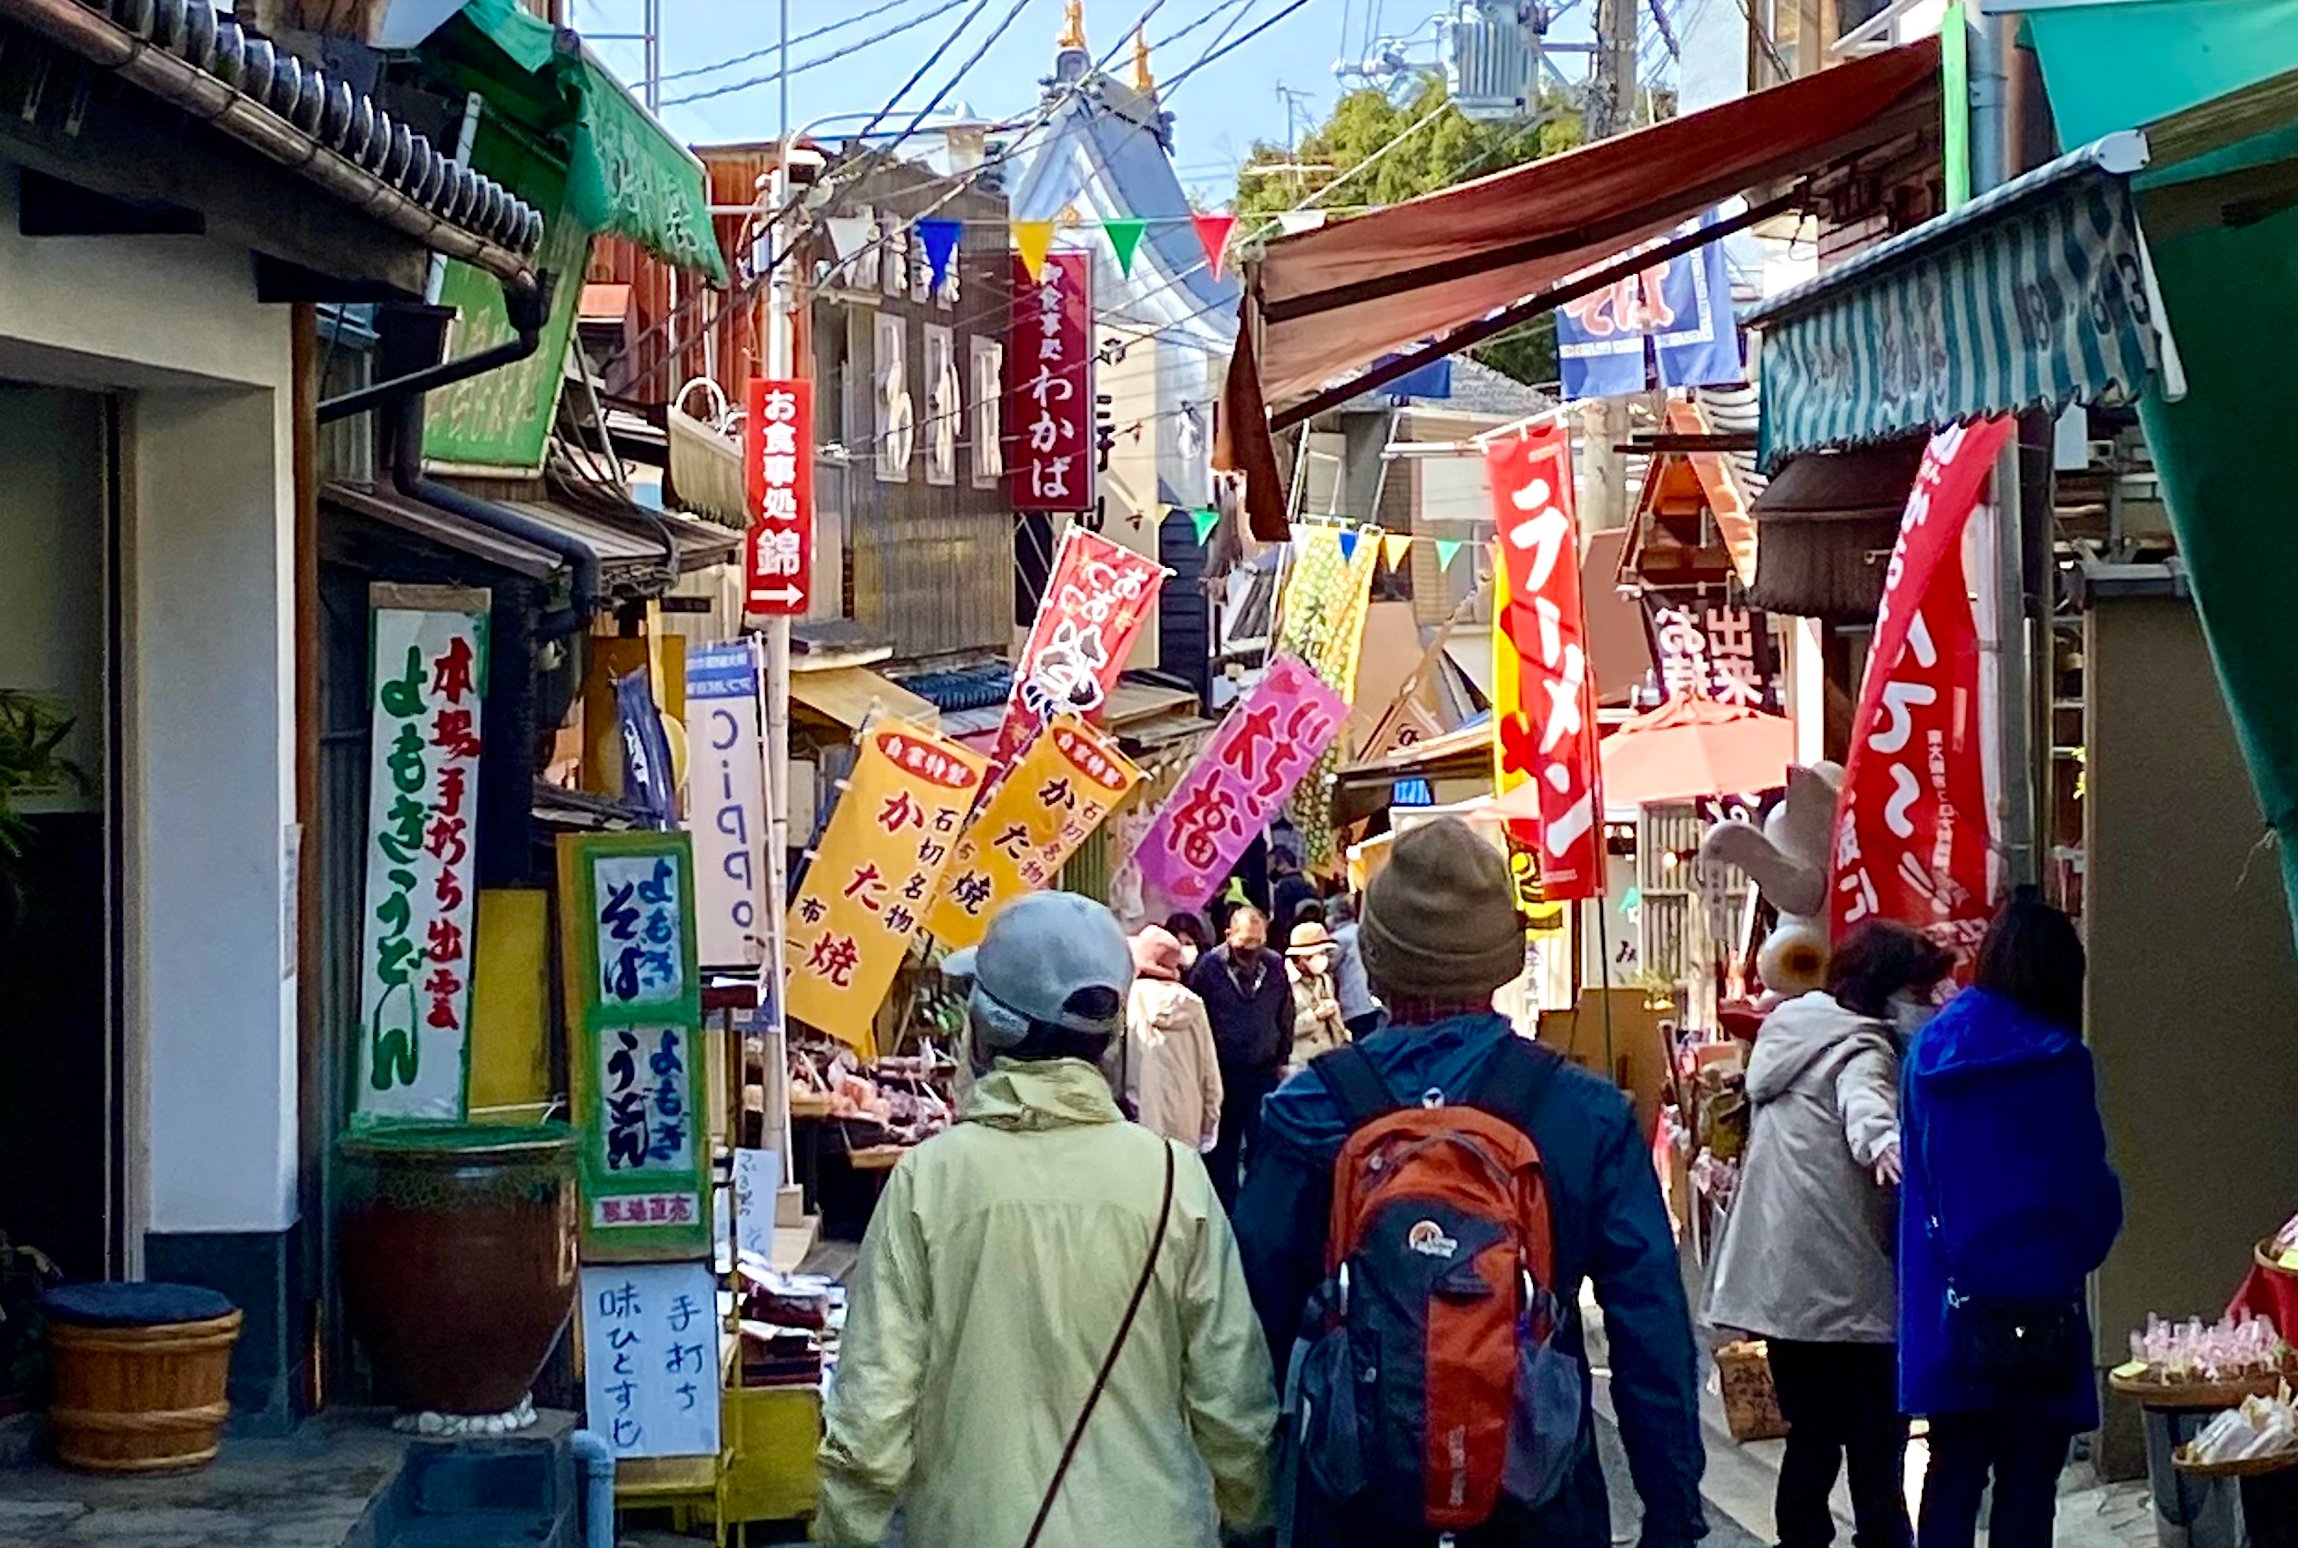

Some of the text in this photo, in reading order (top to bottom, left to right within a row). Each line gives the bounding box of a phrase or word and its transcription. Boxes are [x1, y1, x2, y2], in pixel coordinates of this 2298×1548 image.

[1029, 364, 1075, 497] わかば
[1510, 477, 1594, 859] ラーメン
[371, 645, 432, 1090] よもぎうどん
[805, 791, 925, 988] かた焼
[885, 806, 960, 934] 石切名物
[952, 778, 1076, 915] かた焼
[1021, 799, 1105, 884] 石切名物
[601, 880, 646, 1001] そば
[637, 859, 674, 988] よもぎ
[606, 1030, 652, 1170] うどん
[649, 1029, 690, 1161] よもぎ
[666, 1294, 703, 1411] 手打ち
